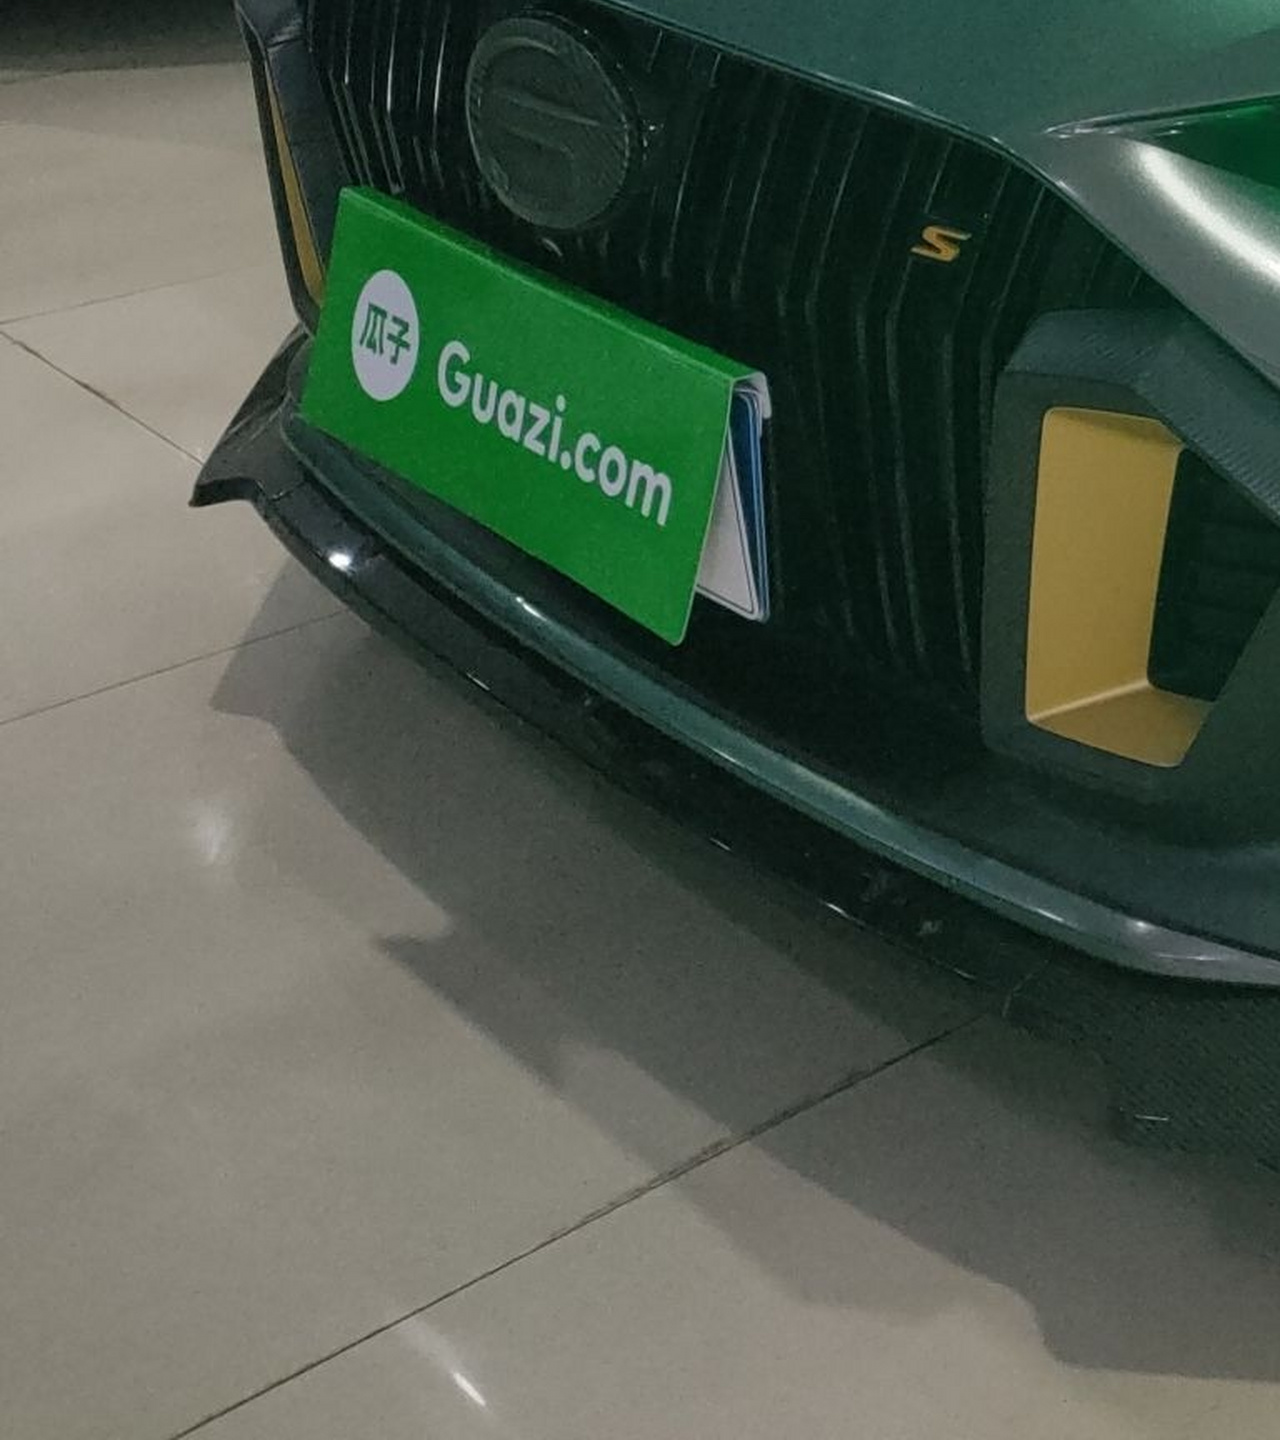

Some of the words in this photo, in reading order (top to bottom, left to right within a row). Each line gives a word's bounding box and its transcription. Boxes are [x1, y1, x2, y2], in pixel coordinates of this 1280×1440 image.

[910, 226, 972, 261] S
[358, 302, 412, 365] 瓜子
[437, 340, 673, 526] Guazi.com
